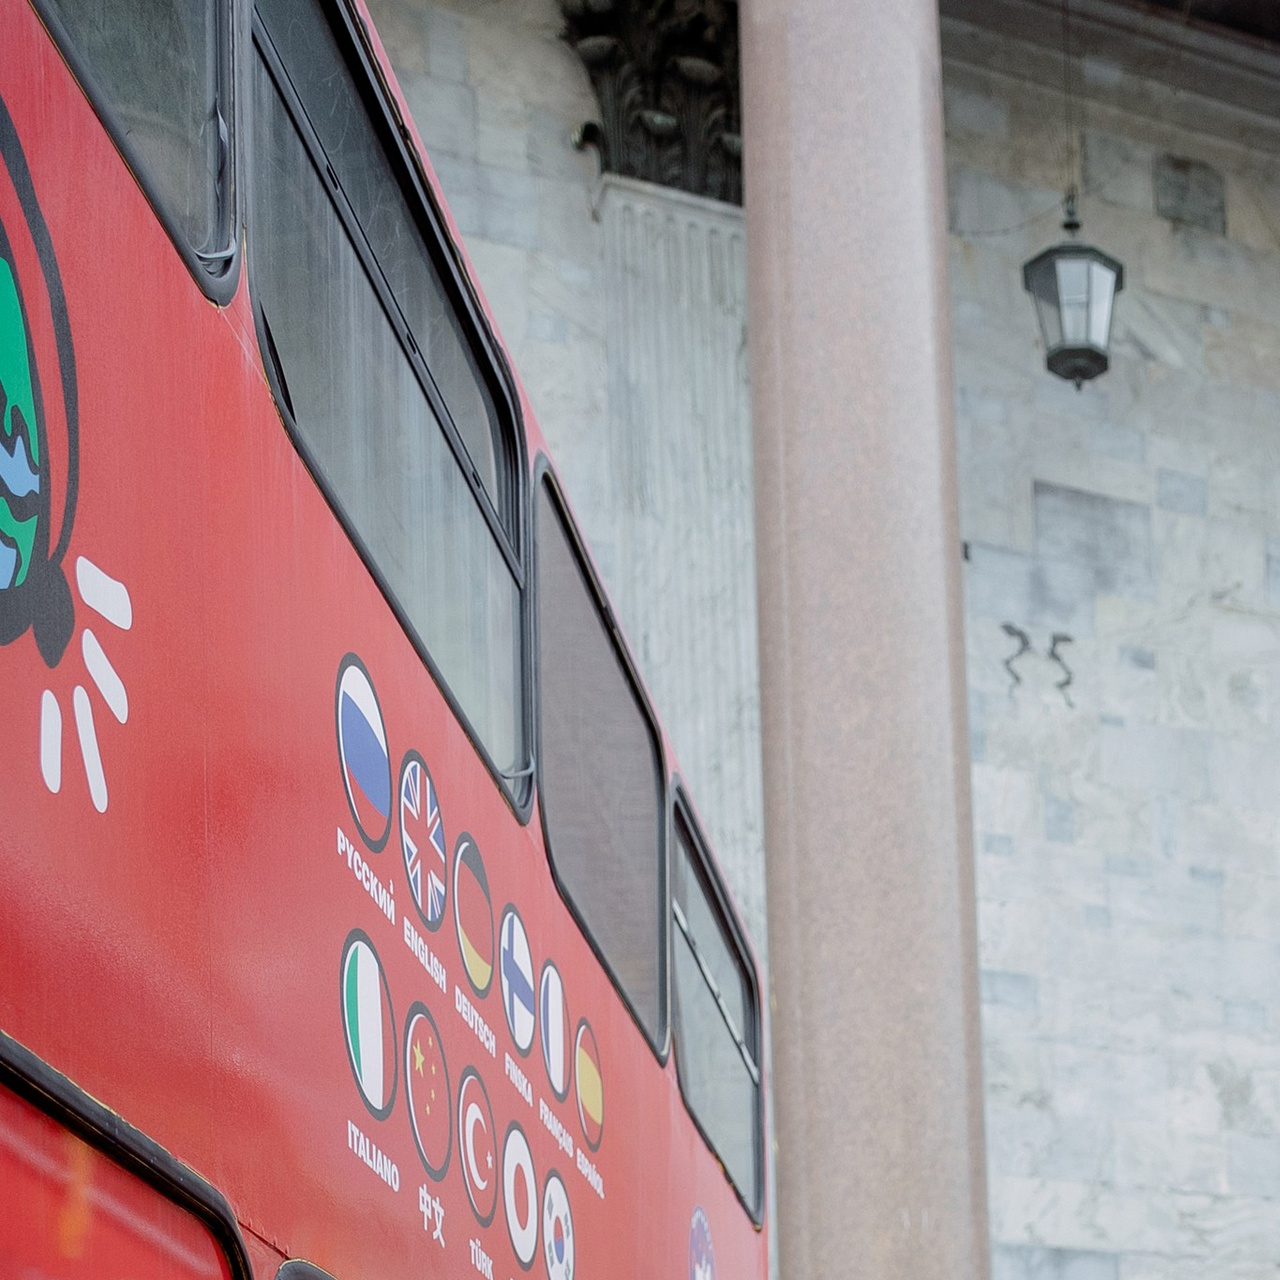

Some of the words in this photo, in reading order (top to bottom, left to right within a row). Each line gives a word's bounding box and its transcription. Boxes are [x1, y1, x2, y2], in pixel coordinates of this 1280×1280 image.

[336, 827, 396, 926] РУССКИЙ
[403, 916, 447, 993] ENGLISH
[454, 985, 496, 1058] DEUTSCH
[505, 1052, 533, 1107] FINSKA
[347, 1119, 400, 1192] ITALIANO
[539, 1098, 574, 1158] FRANÇAIS
[418, 1183, 446, 1248] 中文
